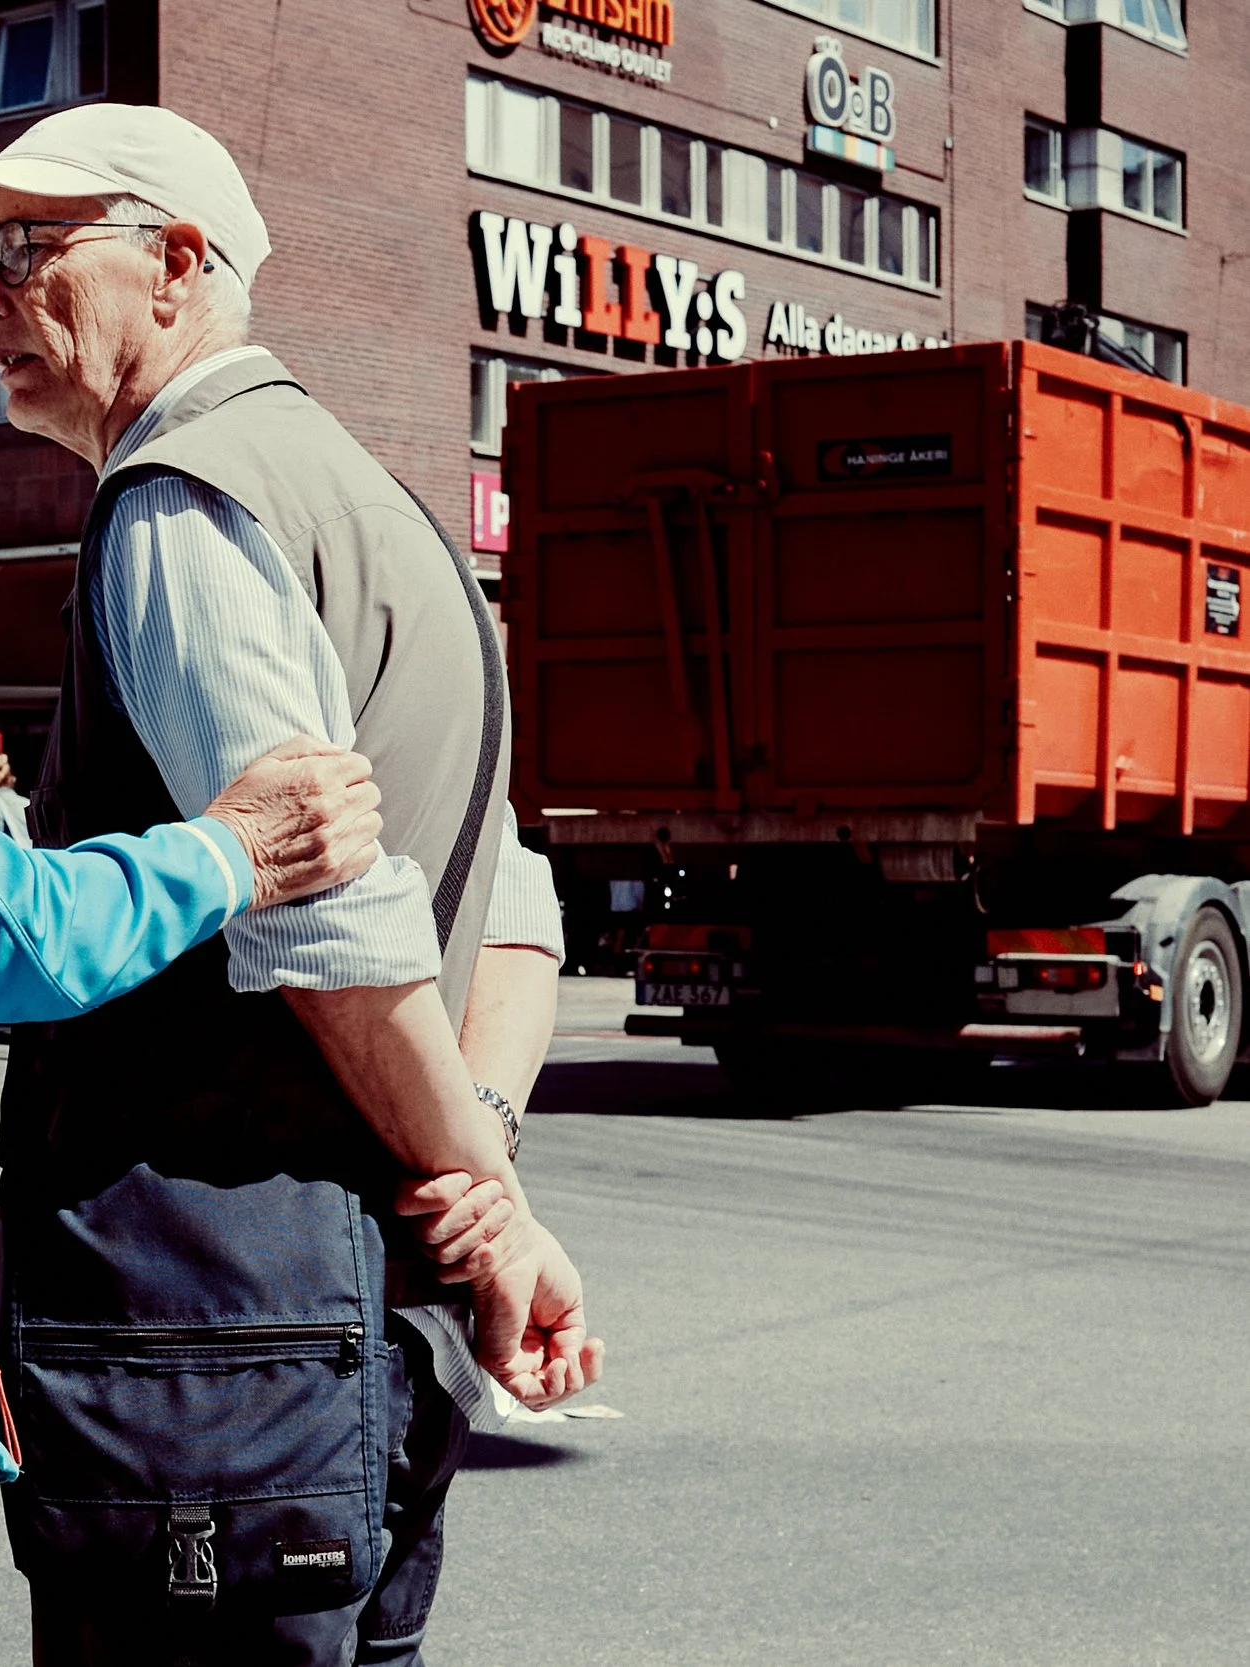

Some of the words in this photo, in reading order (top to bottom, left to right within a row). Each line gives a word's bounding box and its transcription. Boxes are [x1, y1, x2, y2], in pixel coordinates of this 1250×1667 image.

[542, 23, 620, 67] RECYCLING
[621, 48, 672, 83] OUTLET
[768, 301, 821, 351] Alla
[909, 448, 948, 462] ÅKERI
[283, 1554, 308, 1566] JOHN
[309, 1551, 346, 1565] PETERS
